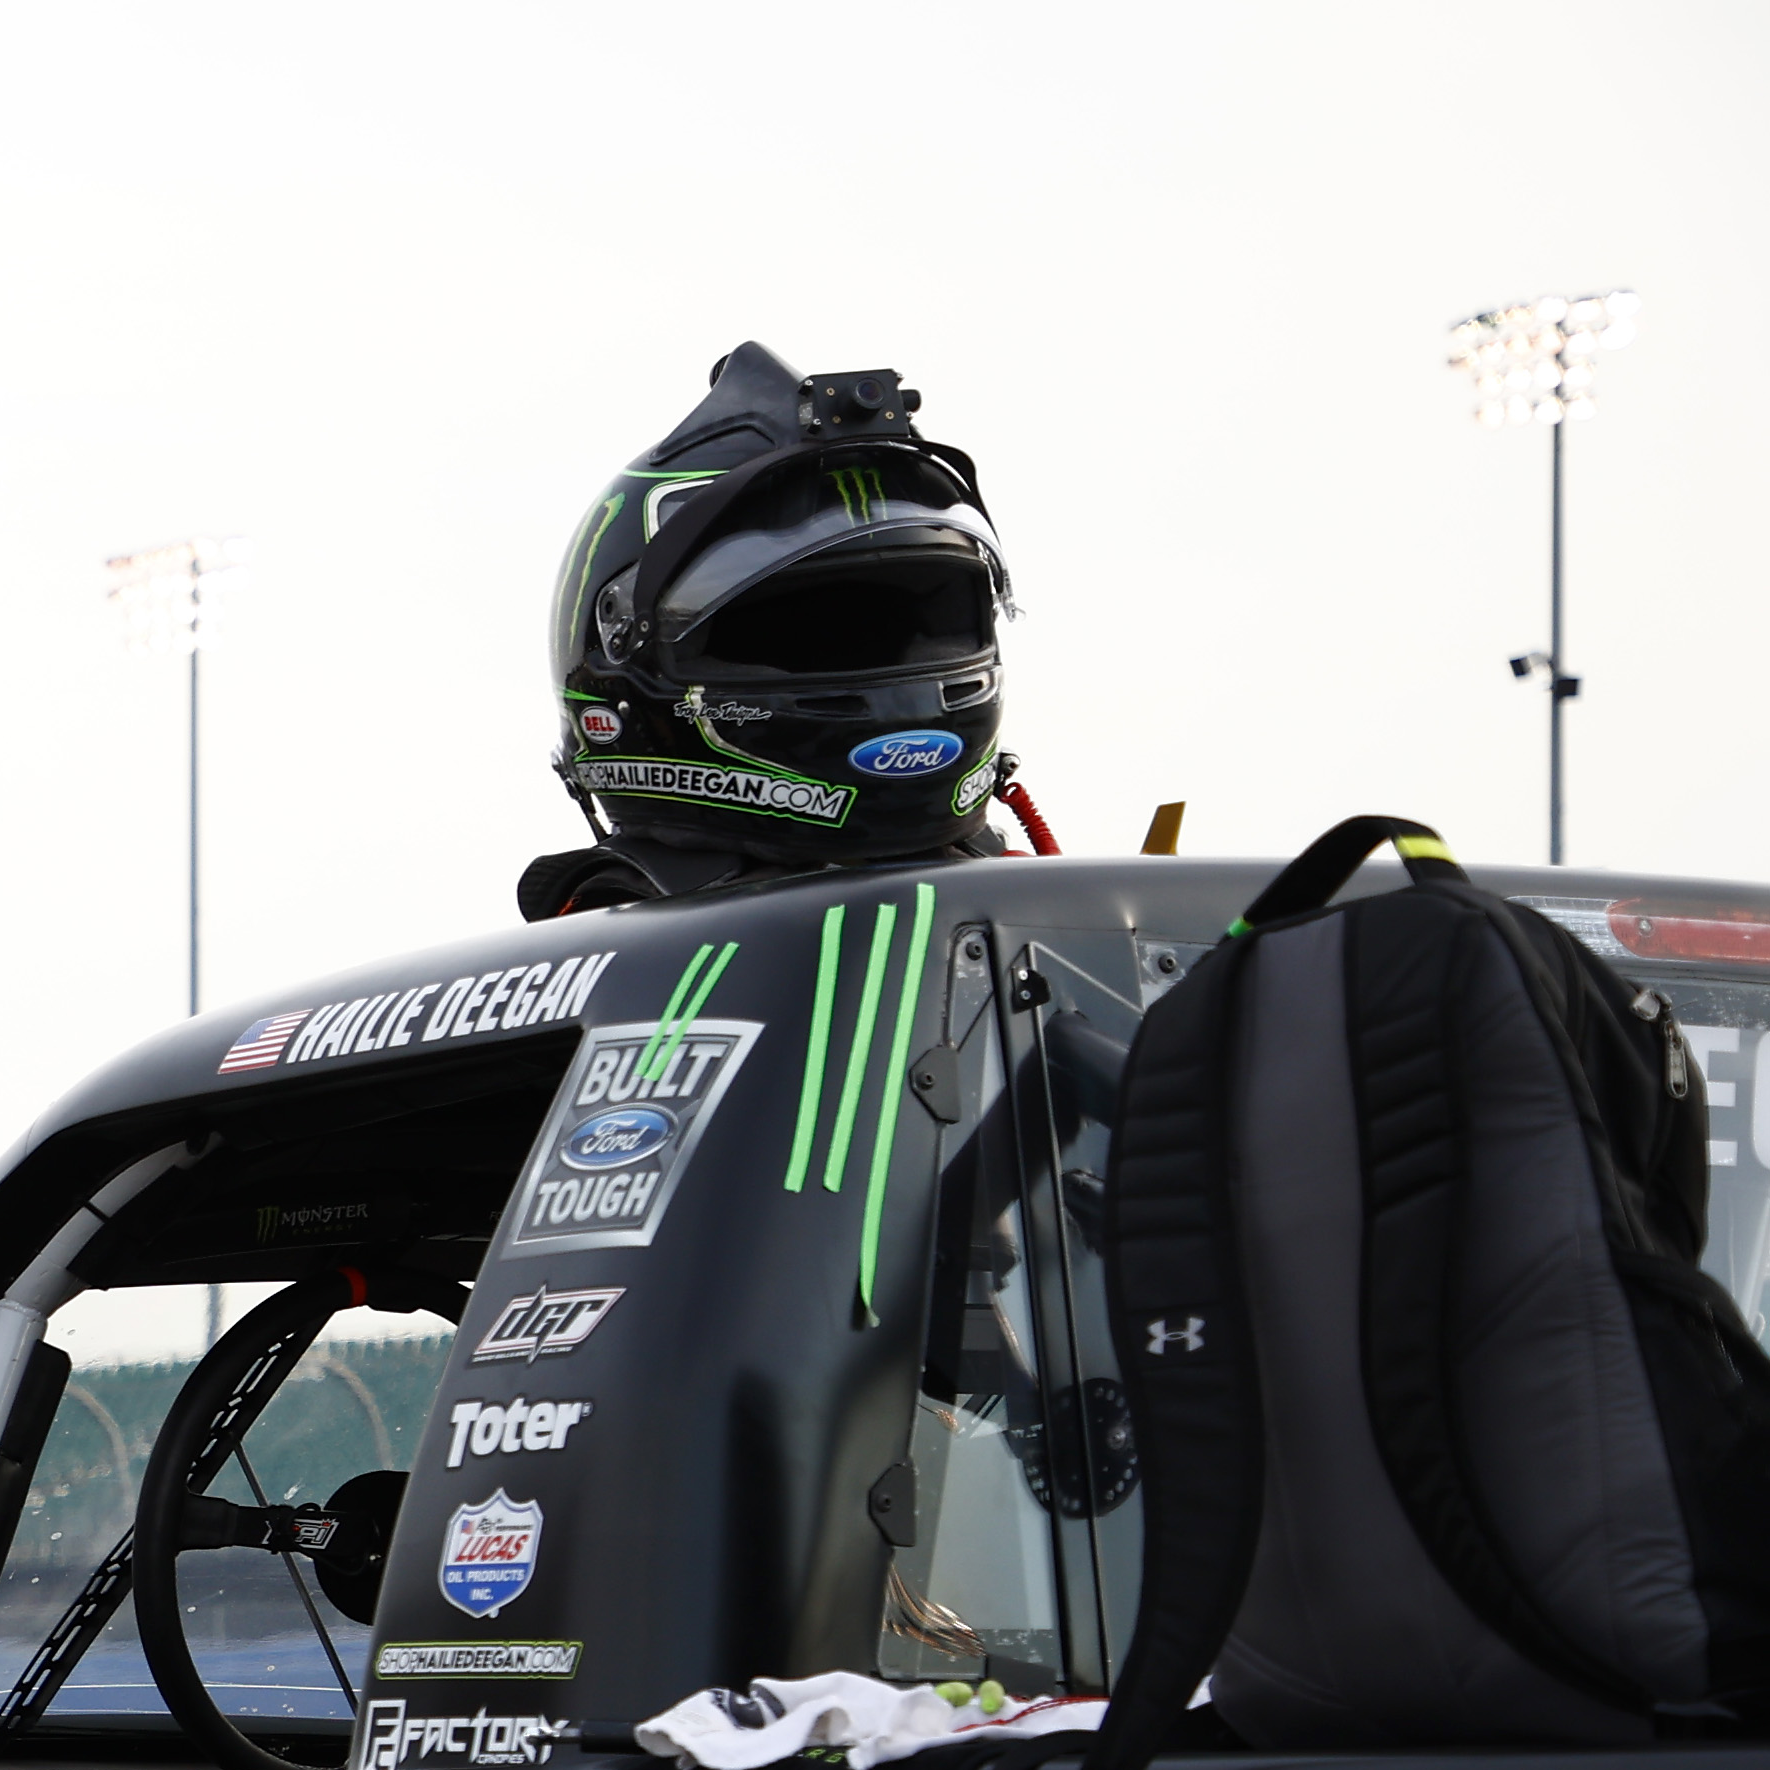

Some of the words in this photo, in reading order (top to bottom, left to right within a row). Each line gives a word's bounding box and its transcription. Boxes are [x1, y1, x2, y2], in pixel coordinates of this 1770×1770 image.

[584, 715, 617, 731] BELL
[675, 702, 697, 723] Troy
[874, 738, 945, 771] Ford
[286, 983, 437, 1065] HAILIE
[422, 952, 617, 1044] DEEGAN
[576, 1043, 726, 1107] BUILT
[580, 1117, 653, 1157] Ford
[532, 1171, 660, 1228] TOUGH
[281, 1203, 369, 1227] MONSTER
[446, 1398, 583, 1469] Toter
[455, 1534, 529, 1562] LUCAS
[446, 1571, 464, 1583] OIL
[466, 1569, 526, 1583] PRODUCTS
[470, 1588, 494, 1601] INC.
[379, 1646, 578, 1673] SHOPHAILIEDEEGAN.COM
